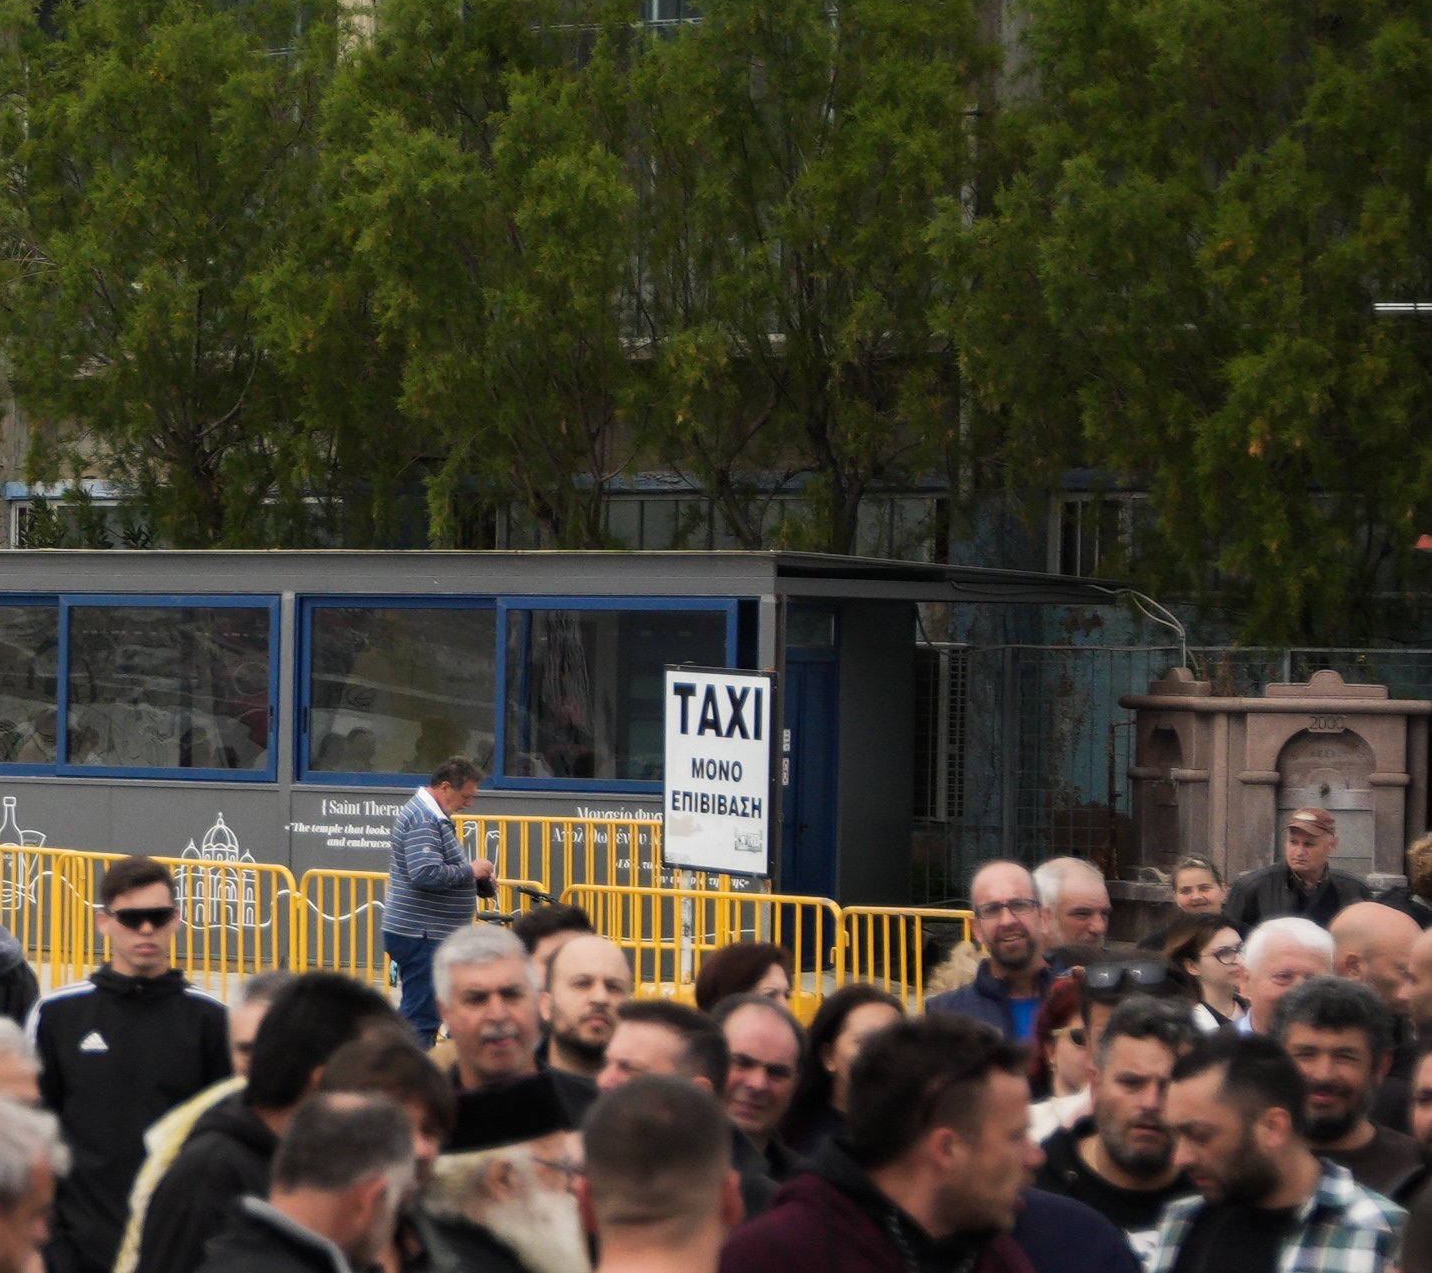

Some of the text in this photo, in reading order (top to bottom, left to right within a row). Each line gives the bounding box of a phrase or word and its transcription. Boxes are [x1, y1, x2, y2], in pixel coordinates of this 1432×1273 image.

[673, 681, 764, 741] TAXI
[1309, 716, 1345, 730] 2000
[691, 757, 743, 783] ΜΟΝΟ
[329, 800, 361, 815] Saint
[671, 790, 763, 820] ΕΠΙΒΙΒΑΣΗ
[327, 837, 345, 847] and
